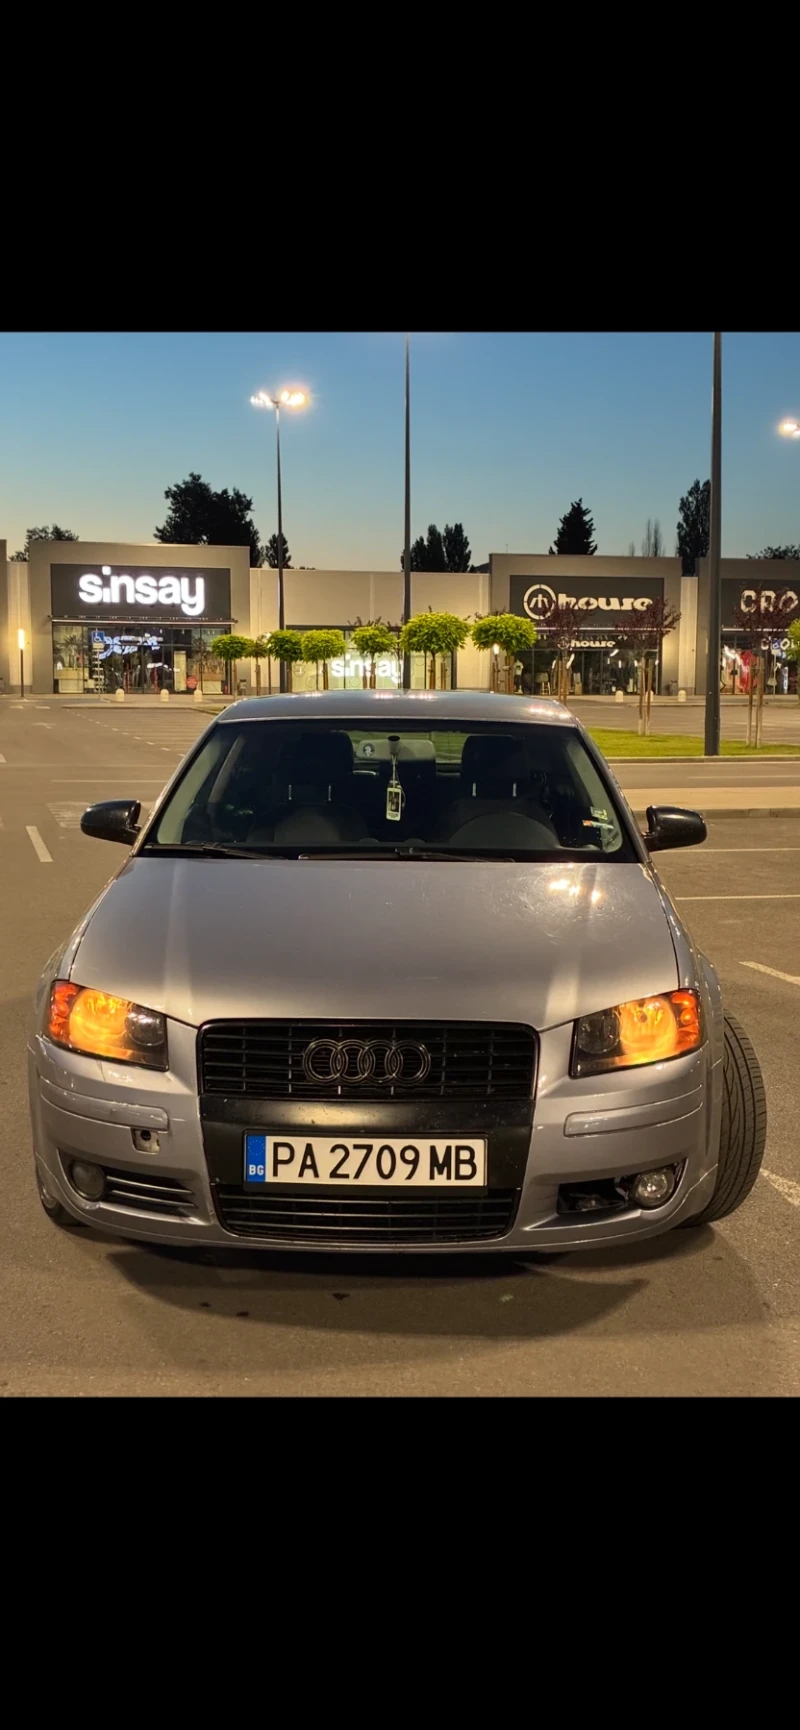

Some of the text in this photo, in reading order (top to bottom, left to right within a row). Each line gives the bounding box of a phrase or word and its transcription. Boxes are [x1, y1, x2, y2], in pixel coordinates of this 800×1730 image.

[78, 566, 205, 616] sinsay
[558, 593, 653, 611] house
[570, 639, 616, 648] house
[248, 1164, 265, 1176] BG
[273, 1142, 477, 1181] PA 2709 MB
